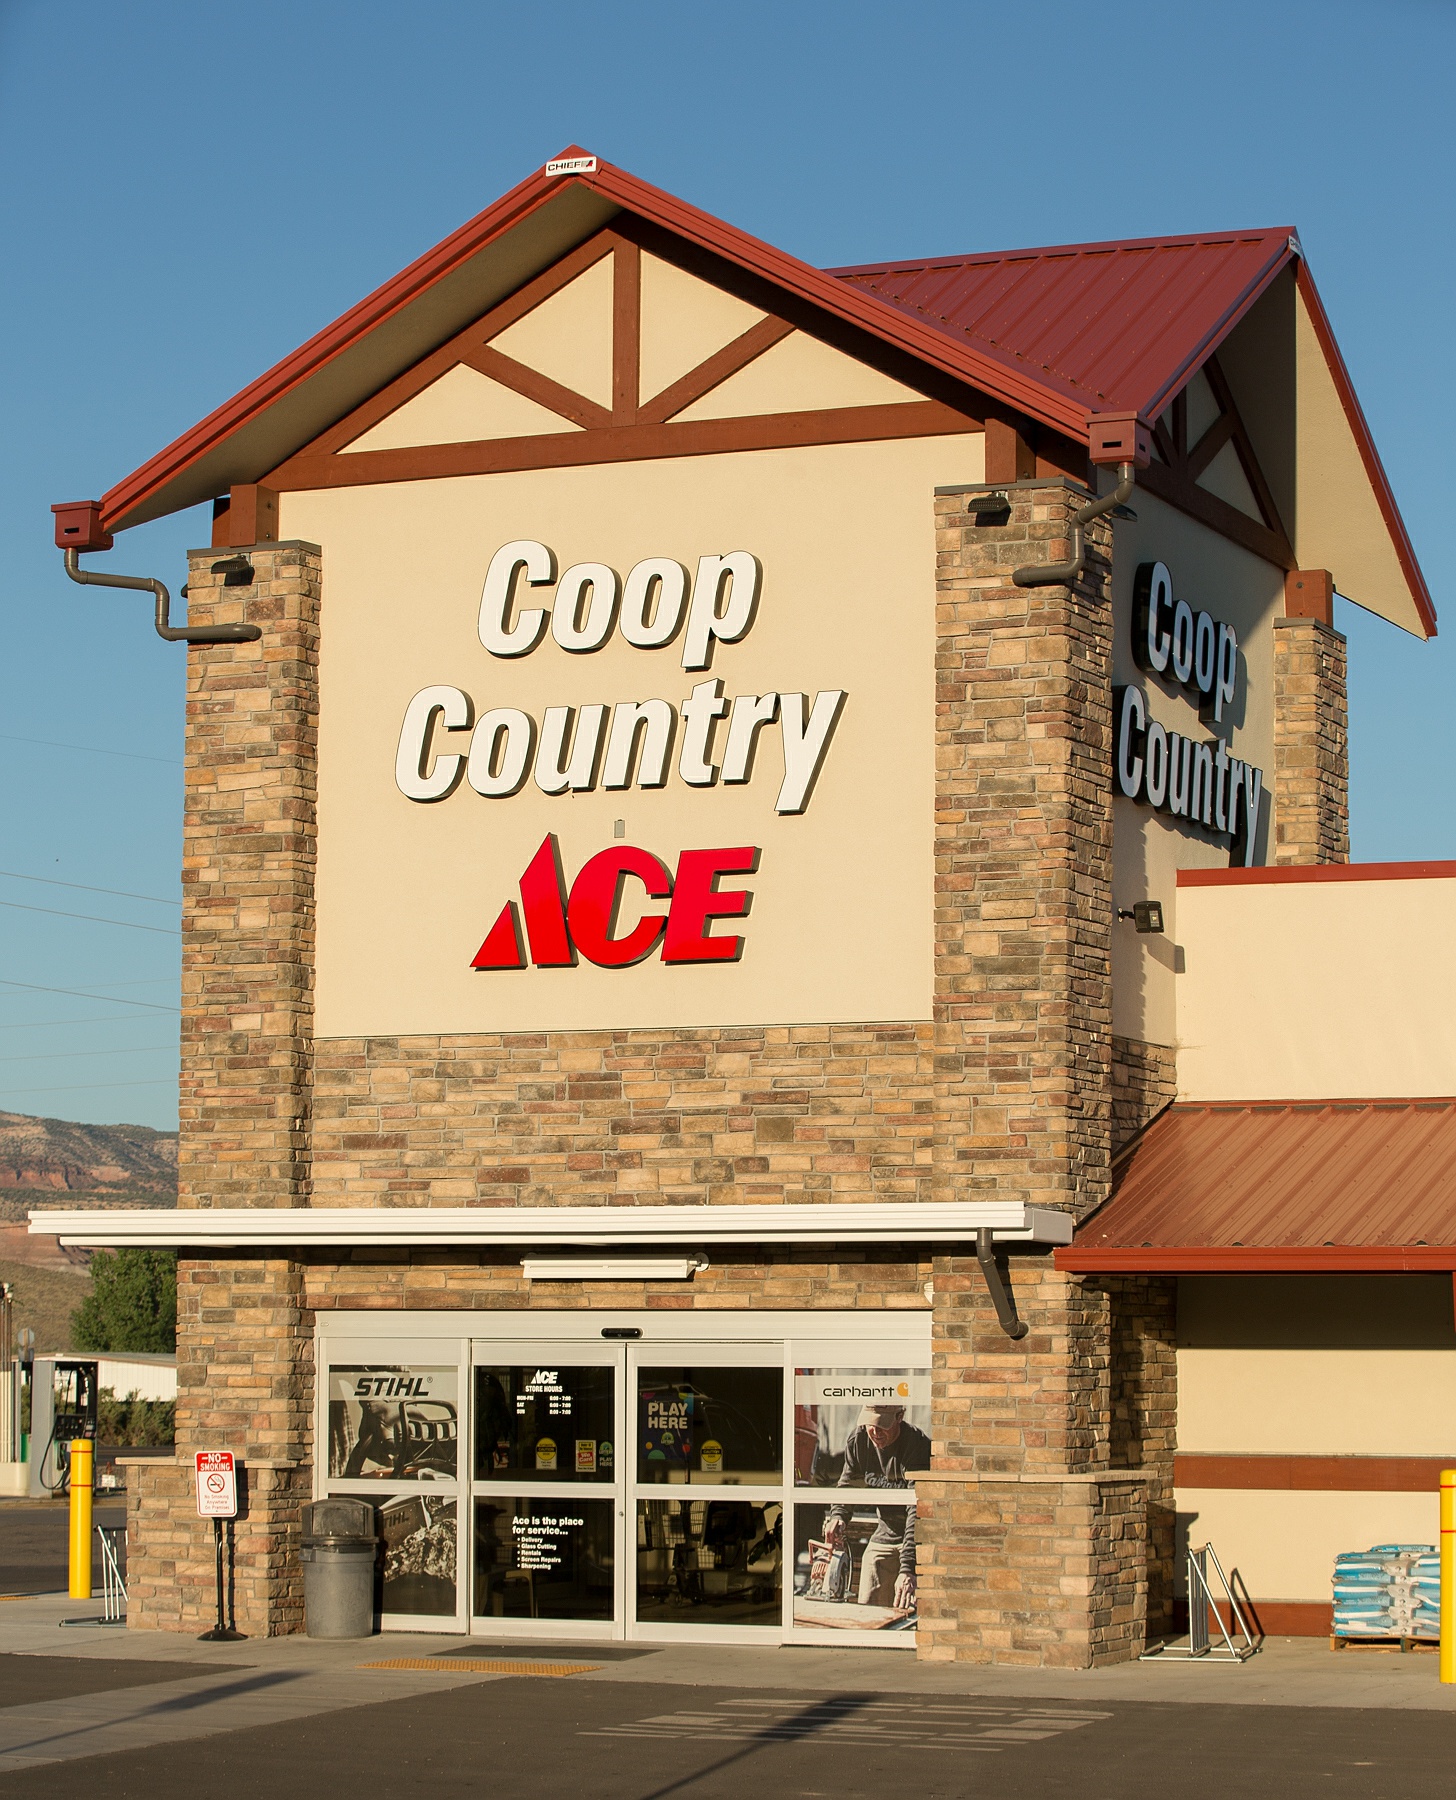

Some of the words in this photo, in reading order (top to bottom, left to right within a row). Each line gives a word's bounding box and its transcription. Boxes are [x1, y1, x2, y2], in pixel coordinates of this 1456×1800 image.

[548, 161, 581, 171] CHIEF
[477, 539, 763, 671] Coop
[1146, 561, 1238, 723] Coop
[394, 677, 848, 815] Country
[1117, 684, 1263, 868] Country
[469, 832, 762, 969] ACE
[531, 1369, 558, 1384] ACE
[823, 1386, 895, 1397] carhartt
[648, 1402, 688, 1416] PLAY
[648, 1416, 688, 1429] HERE
[200, 1463, 231, 1471] SMOKING
[384, 1511, 410, 1528] TIHL
[512, 1516, 530, 1525] Ace
[532, 1516, 540, 1525] is
[542, 1516, 557, 1525] the
[559, 1516, 584, 1527] place
[512, 1525, 526, 1535] for
[537, 1543, 557, 1551] Cutting
